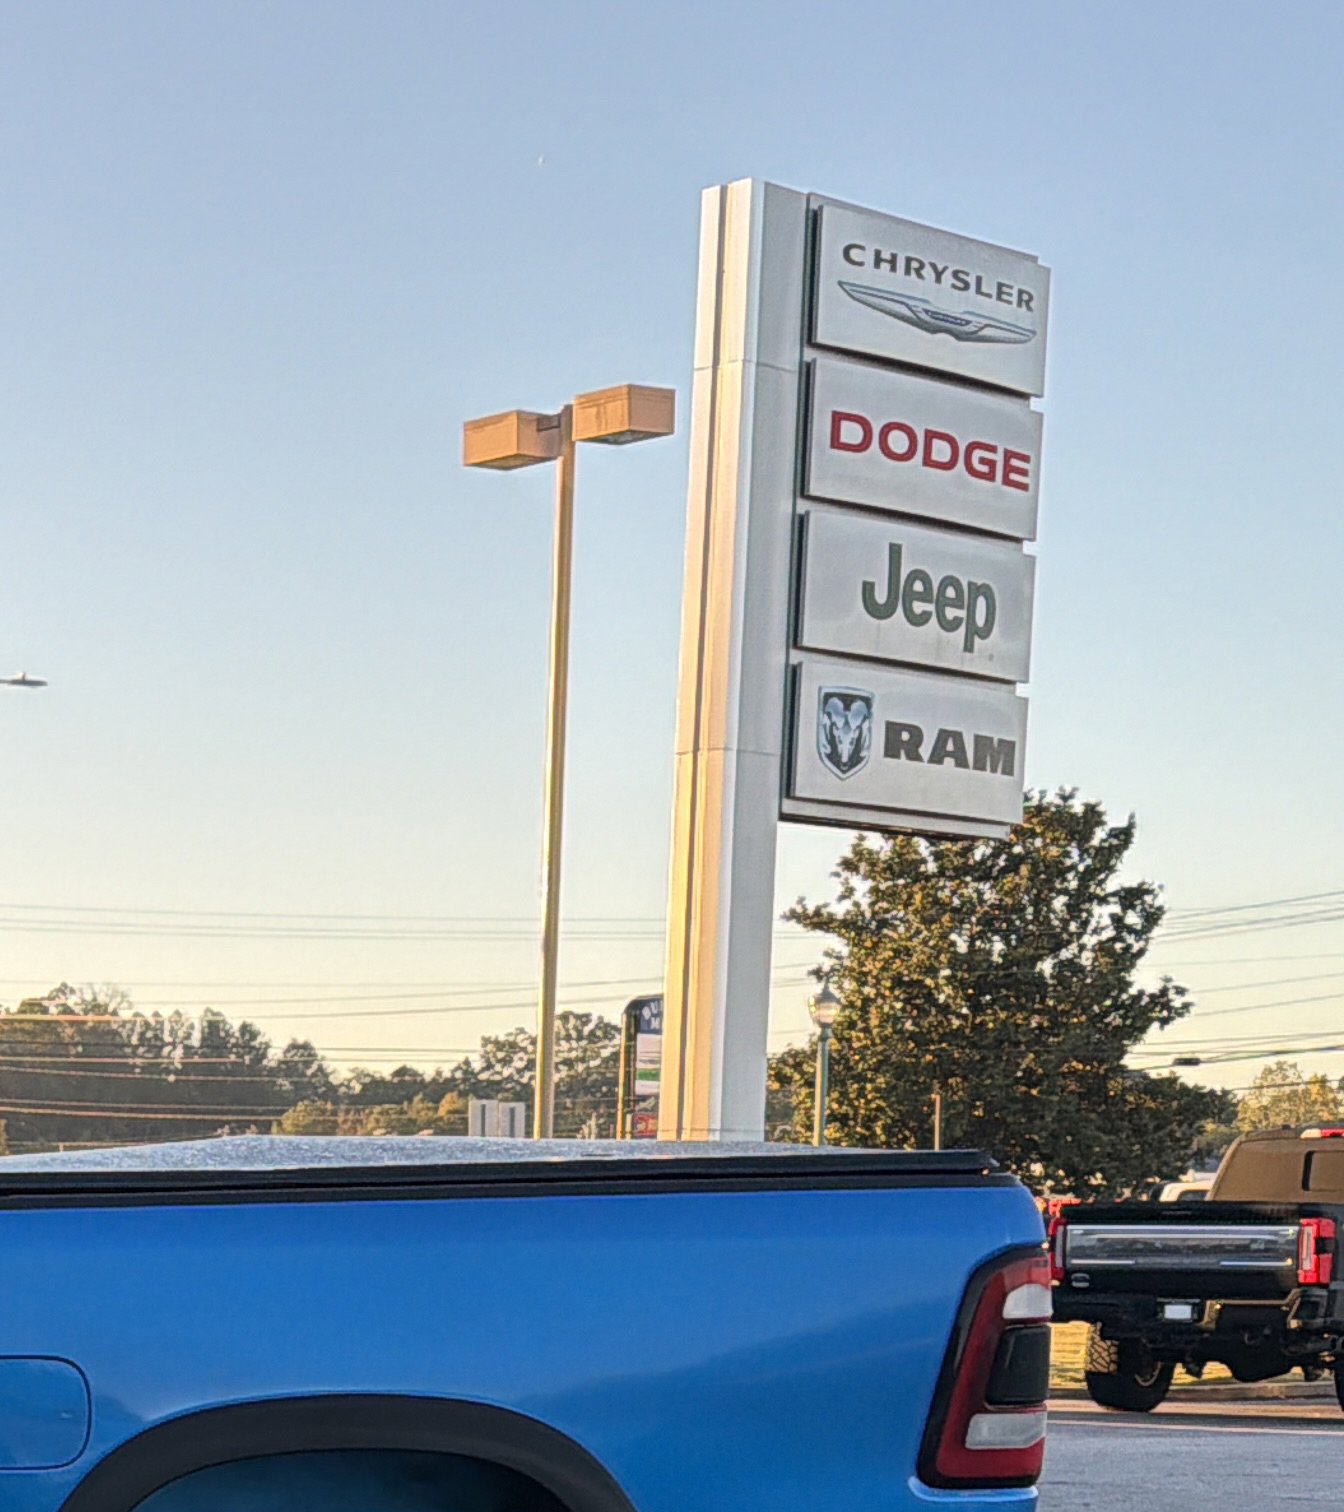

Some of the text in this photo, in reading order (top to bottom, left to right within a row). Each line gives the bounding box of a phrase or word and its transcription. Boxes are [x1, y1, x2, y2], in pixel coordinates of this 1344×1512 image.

[842, 243, 1035, 312] CHRYSLER
[830, 411, 1031, 491] DODGE
[861, 542, 996, 653] Jeep
[883, 720, 1016, 776] RAM
